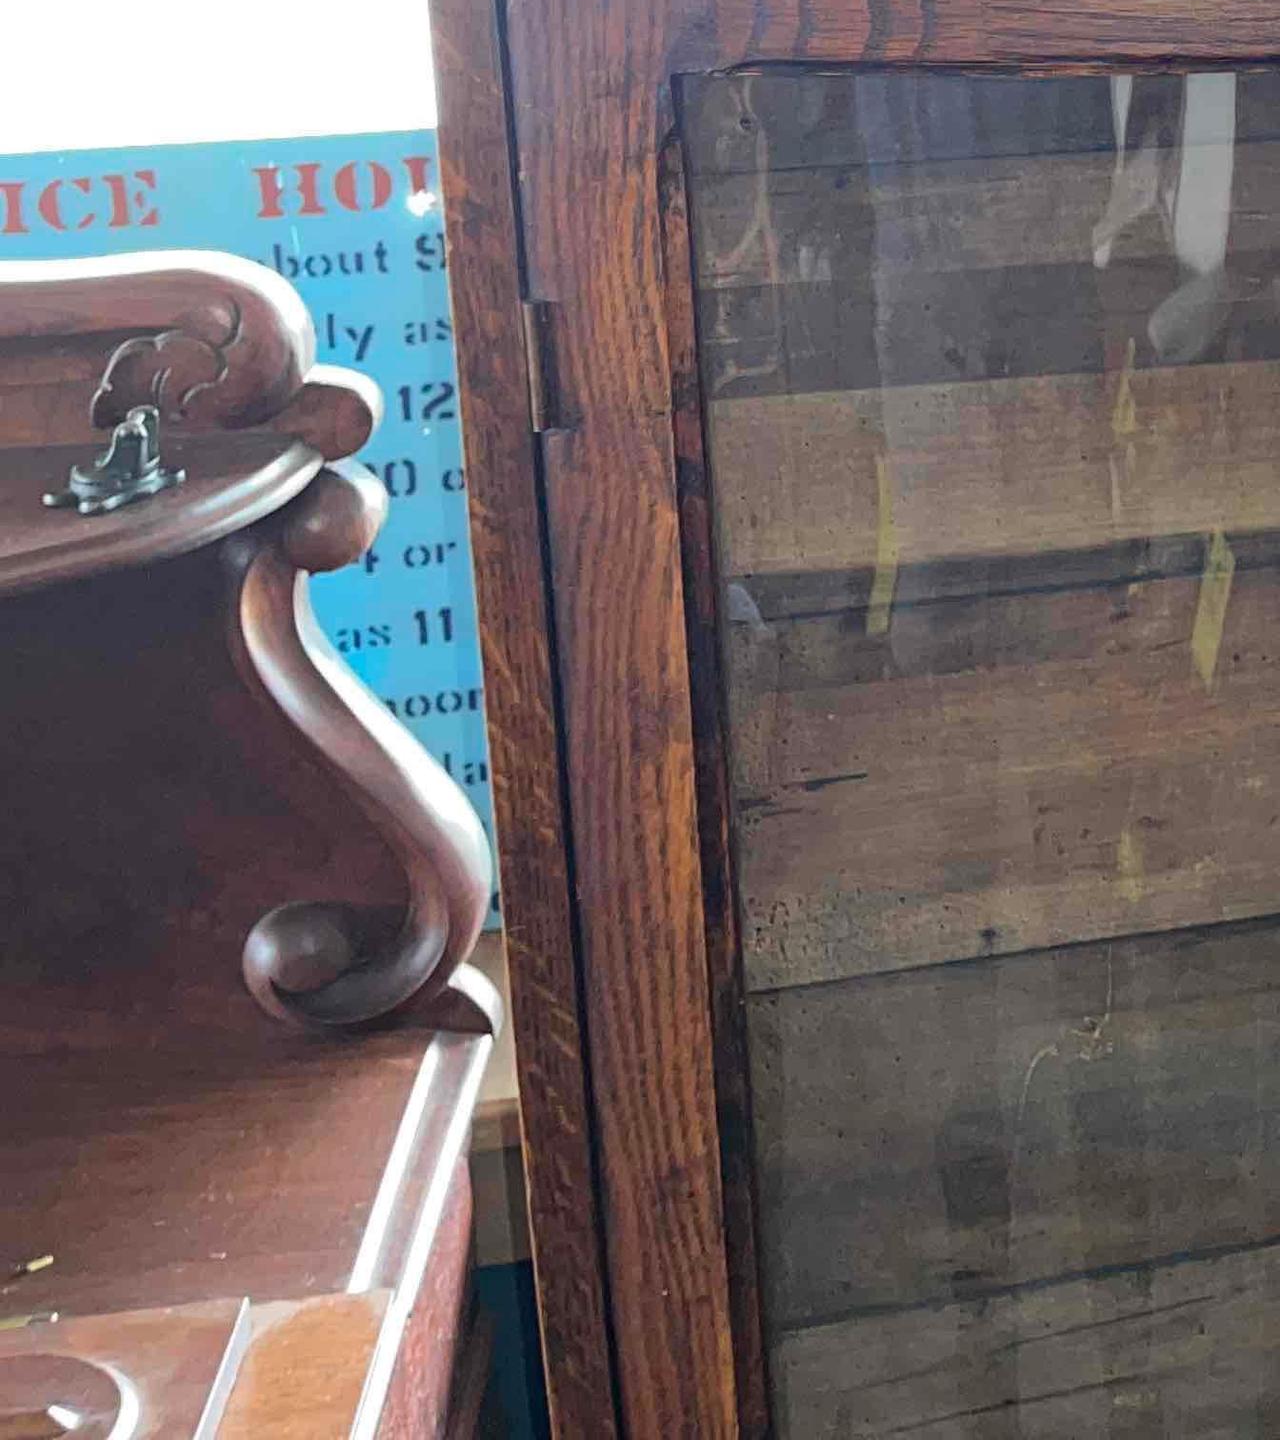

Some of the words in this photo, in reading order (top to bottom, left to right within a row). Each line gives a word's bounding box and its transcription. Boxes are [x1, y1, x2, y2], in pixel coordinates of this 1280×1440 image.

[0, 169, 159, 233] ICE
[257, 240, 388, 278] bout
[398, 382, 455, 421] 12
[364, 459, 417, 498] 0
[403, 541, 456, 568] or
[333, 623, 393, 652] as
[414, 607, 453, 646] 11
